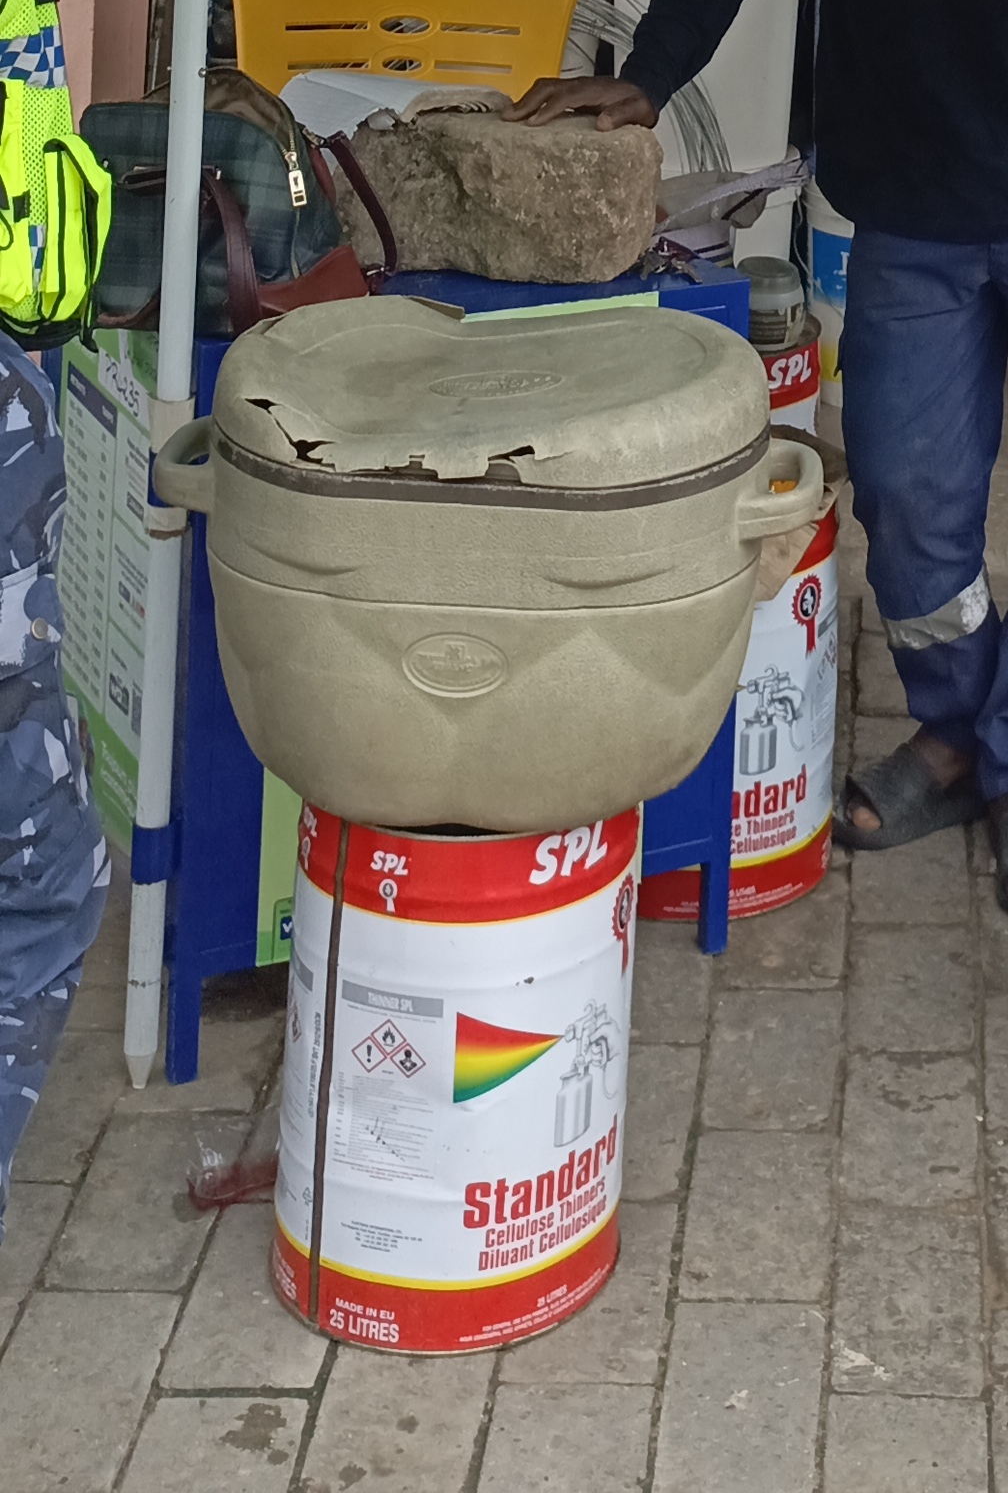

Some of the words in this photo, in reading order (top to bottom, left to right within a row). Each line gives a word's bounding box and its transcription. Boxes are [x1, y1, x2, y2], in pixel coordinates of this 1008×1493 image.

[768, 350, 812, 390] SPL
[746, 810, 795, 835] Thinners
[370, 850, 409, 876] SPL
[529, 819, 608, 886] SPL
[367, 992, 399, 1011] THINNER
[400, 997, 413, 1012] SPL
[463, 1113, 618, 1229] Standard
[485, 1211, 555, 1249] Cellulose
[559, 1175, 606, 1223] Thinners
[478, 1239, 535, 1272] Diluant
[538, 1194, 608, 1254] Cellulosique
[329, 1309, 345, 1330] 25
[348, 1315, 400, 1343] LITRES
[335, 1297, 364, 1315] MADE
[366, 1307, 377, 1317] IN
[379, 1310, 395, 1320] EU
